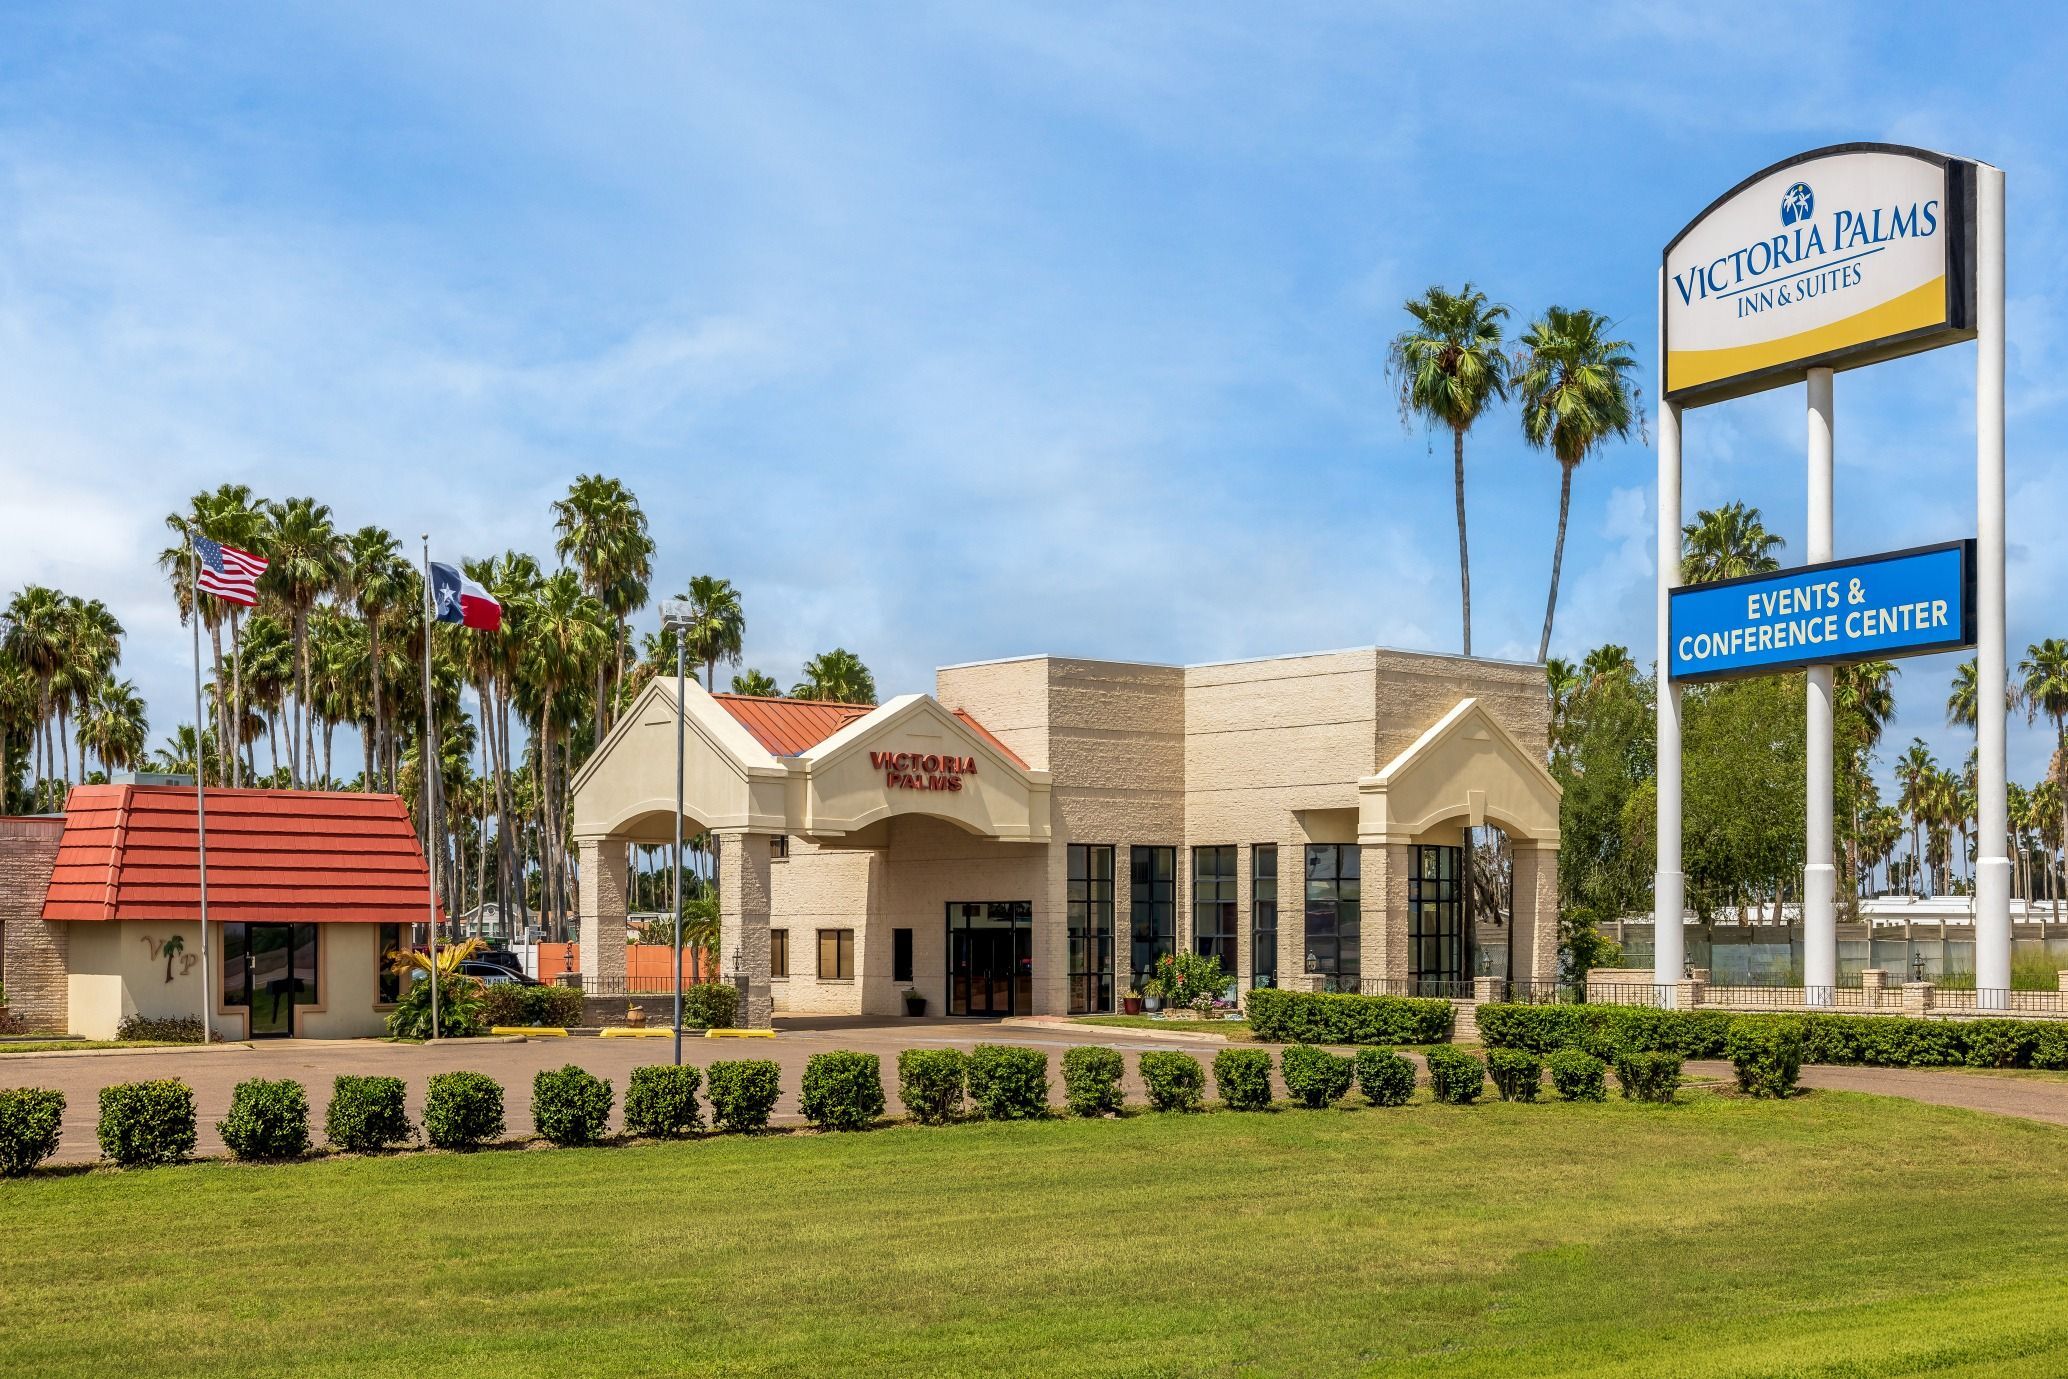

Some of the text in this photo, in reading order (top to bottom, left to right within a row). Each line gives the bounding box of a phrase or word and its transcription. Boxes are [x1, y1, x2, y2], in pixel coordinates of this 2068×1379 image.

[1673, 200, 1938, 306] VICTORIA PALMS
[1737, 262, 1862, 318] INN & SUITES
[1748, 577, 1866, 620] EVENTS &
[1678, 599, 1948, 661] CONFERENCE CENTER
[869, 751, 978, 792] VICTORIA PALMS
